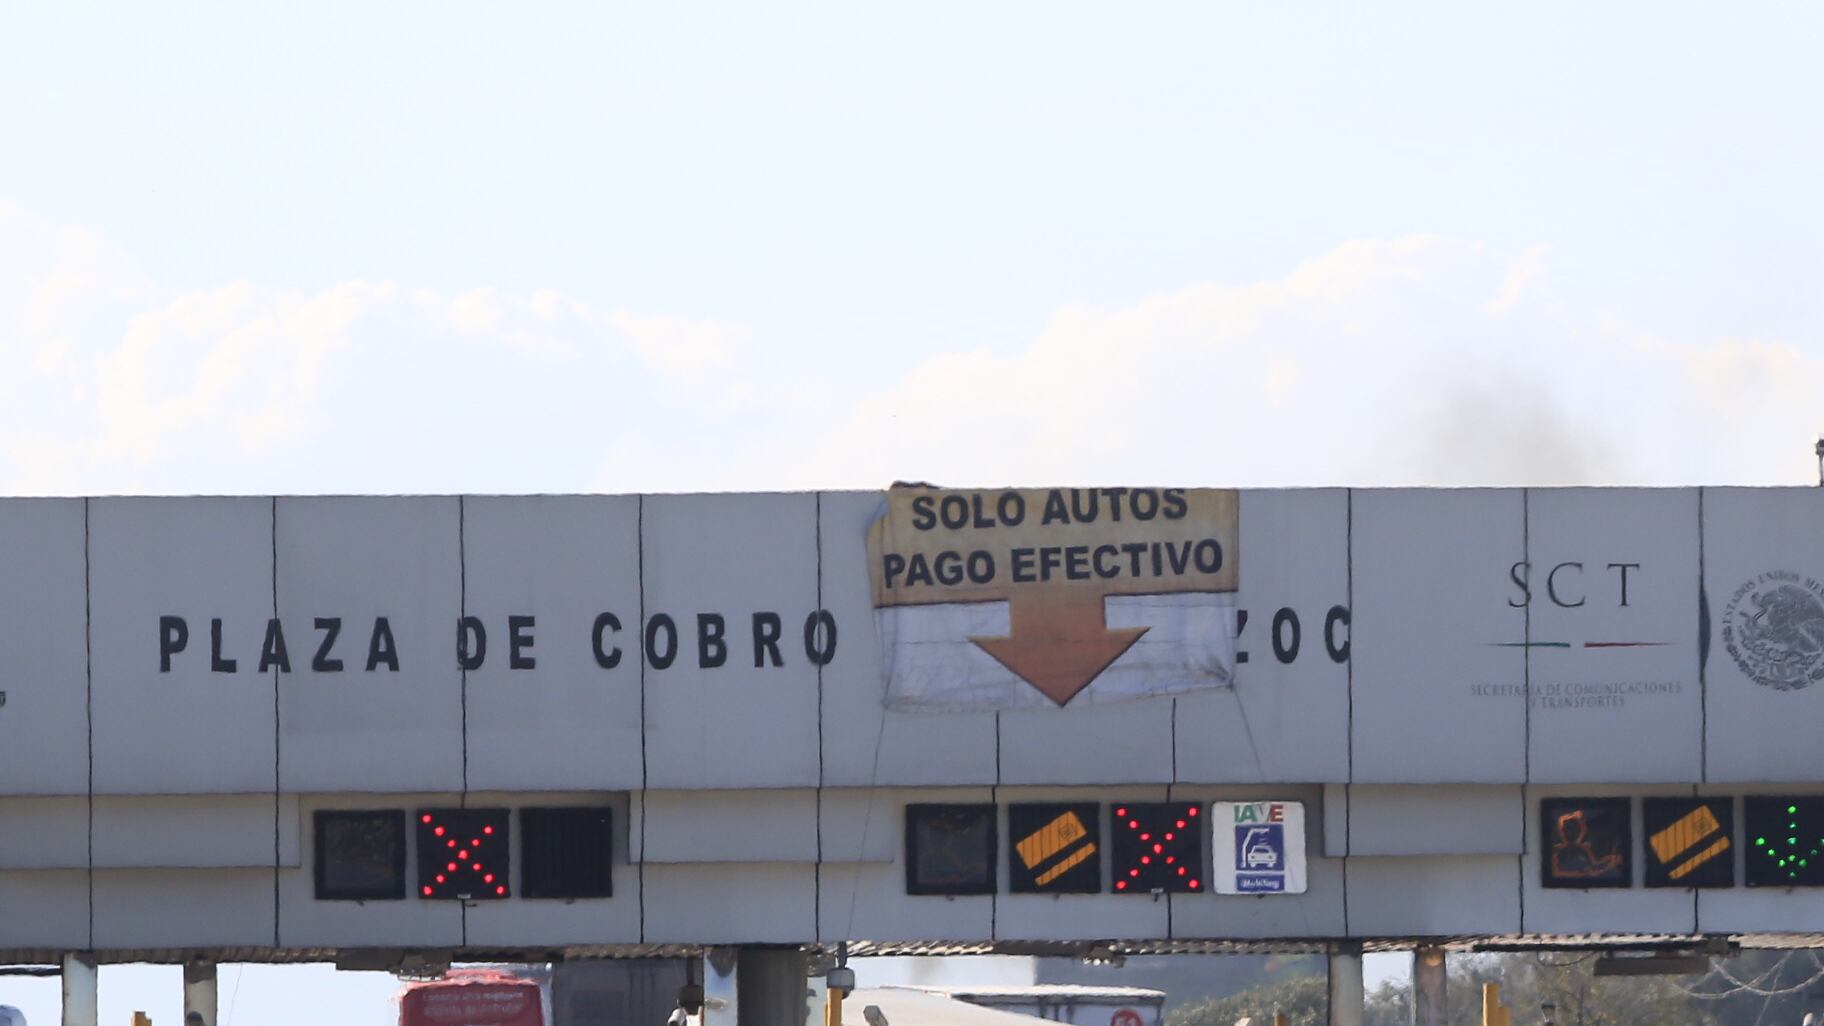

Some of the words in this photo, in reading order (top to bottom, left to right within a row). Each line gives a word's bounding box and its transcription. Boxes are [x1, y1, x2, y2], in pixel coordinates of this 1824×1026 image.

[911, 491, 1026, 531] SOLO
[1041, 486, 1188, 526] AUTOS
[882, 550, 996, 589] PAGO
[1011, 539, 1223, 583] EFECTIVO
[1507, 561, 1640, 608] SCT
[158, 615, 401, 673] PLAZA
[456, 614, 538, 671] DE
[591, 609, 839, 670] COBRO
[1234, 804, 1284, 823] IAVE
